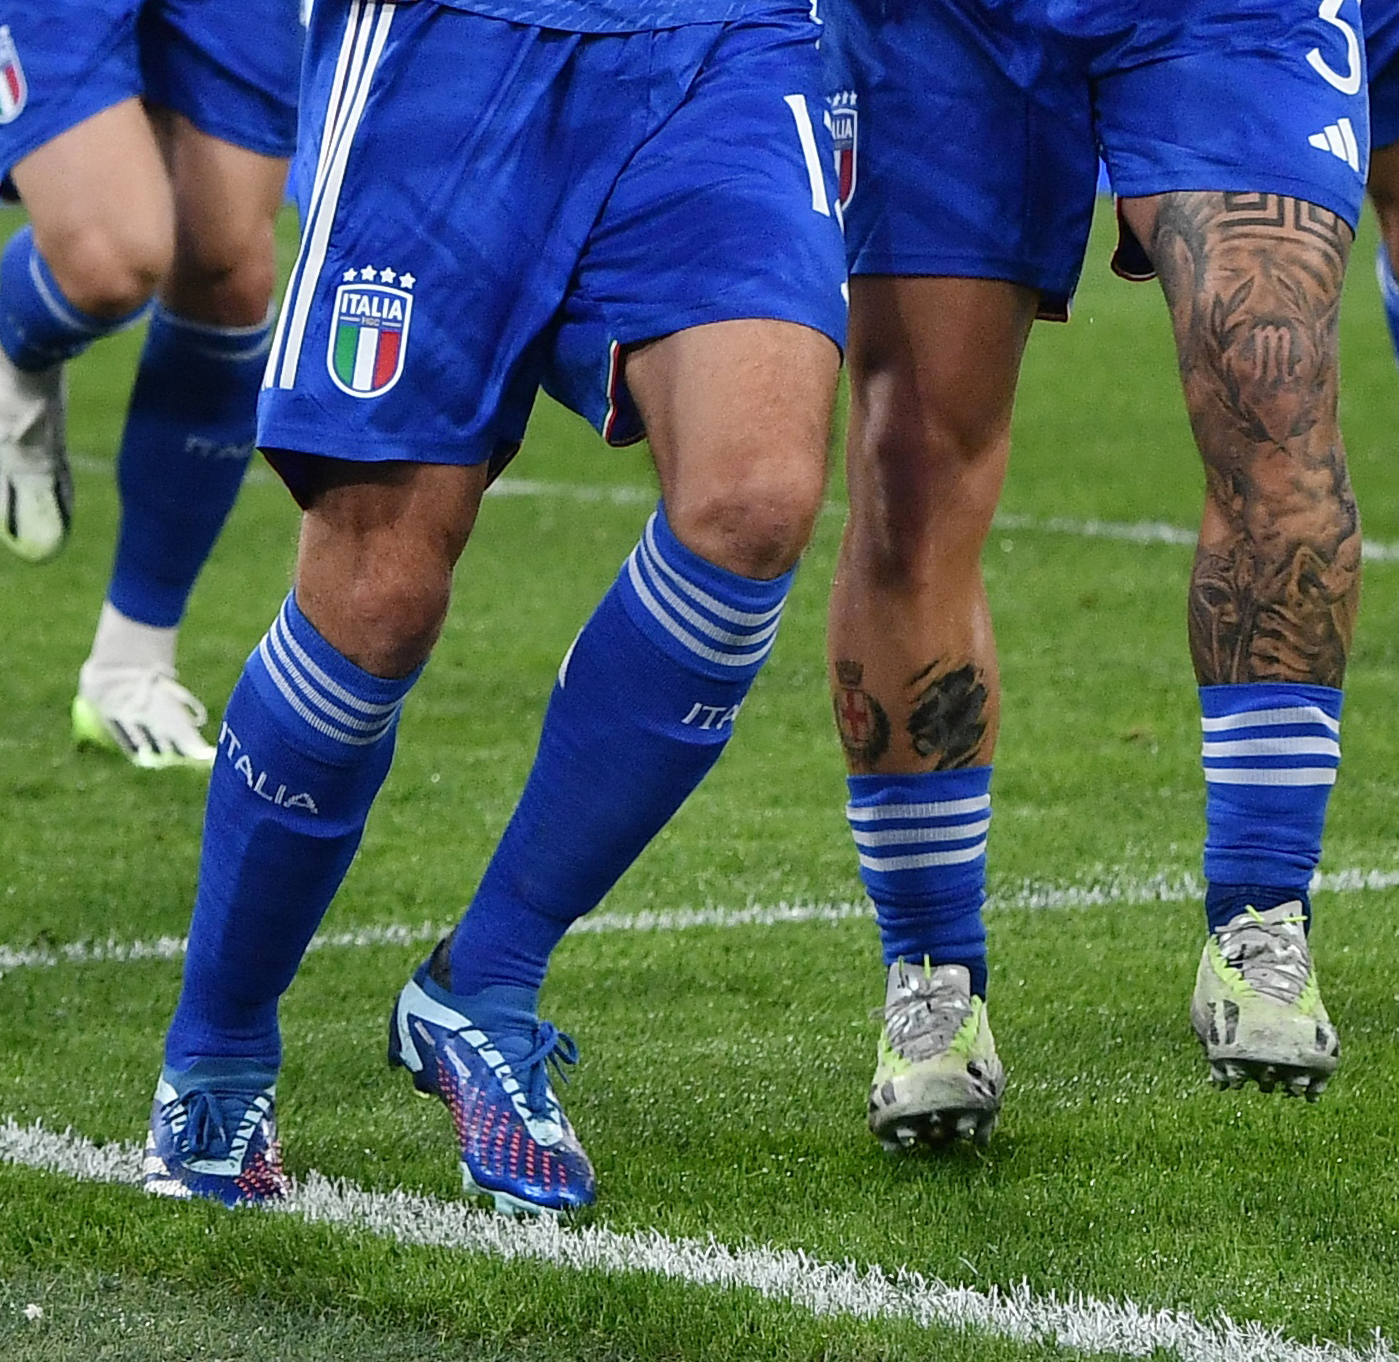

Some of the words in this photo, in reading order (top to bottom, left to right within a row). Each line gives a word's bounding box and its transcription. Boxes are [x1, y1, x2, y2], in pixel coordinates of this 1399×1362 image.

[783, 94, 845, 234] 1
[340, 292, 403, 321] ITALIA
[219, 720, 319, 815] ITALIA
